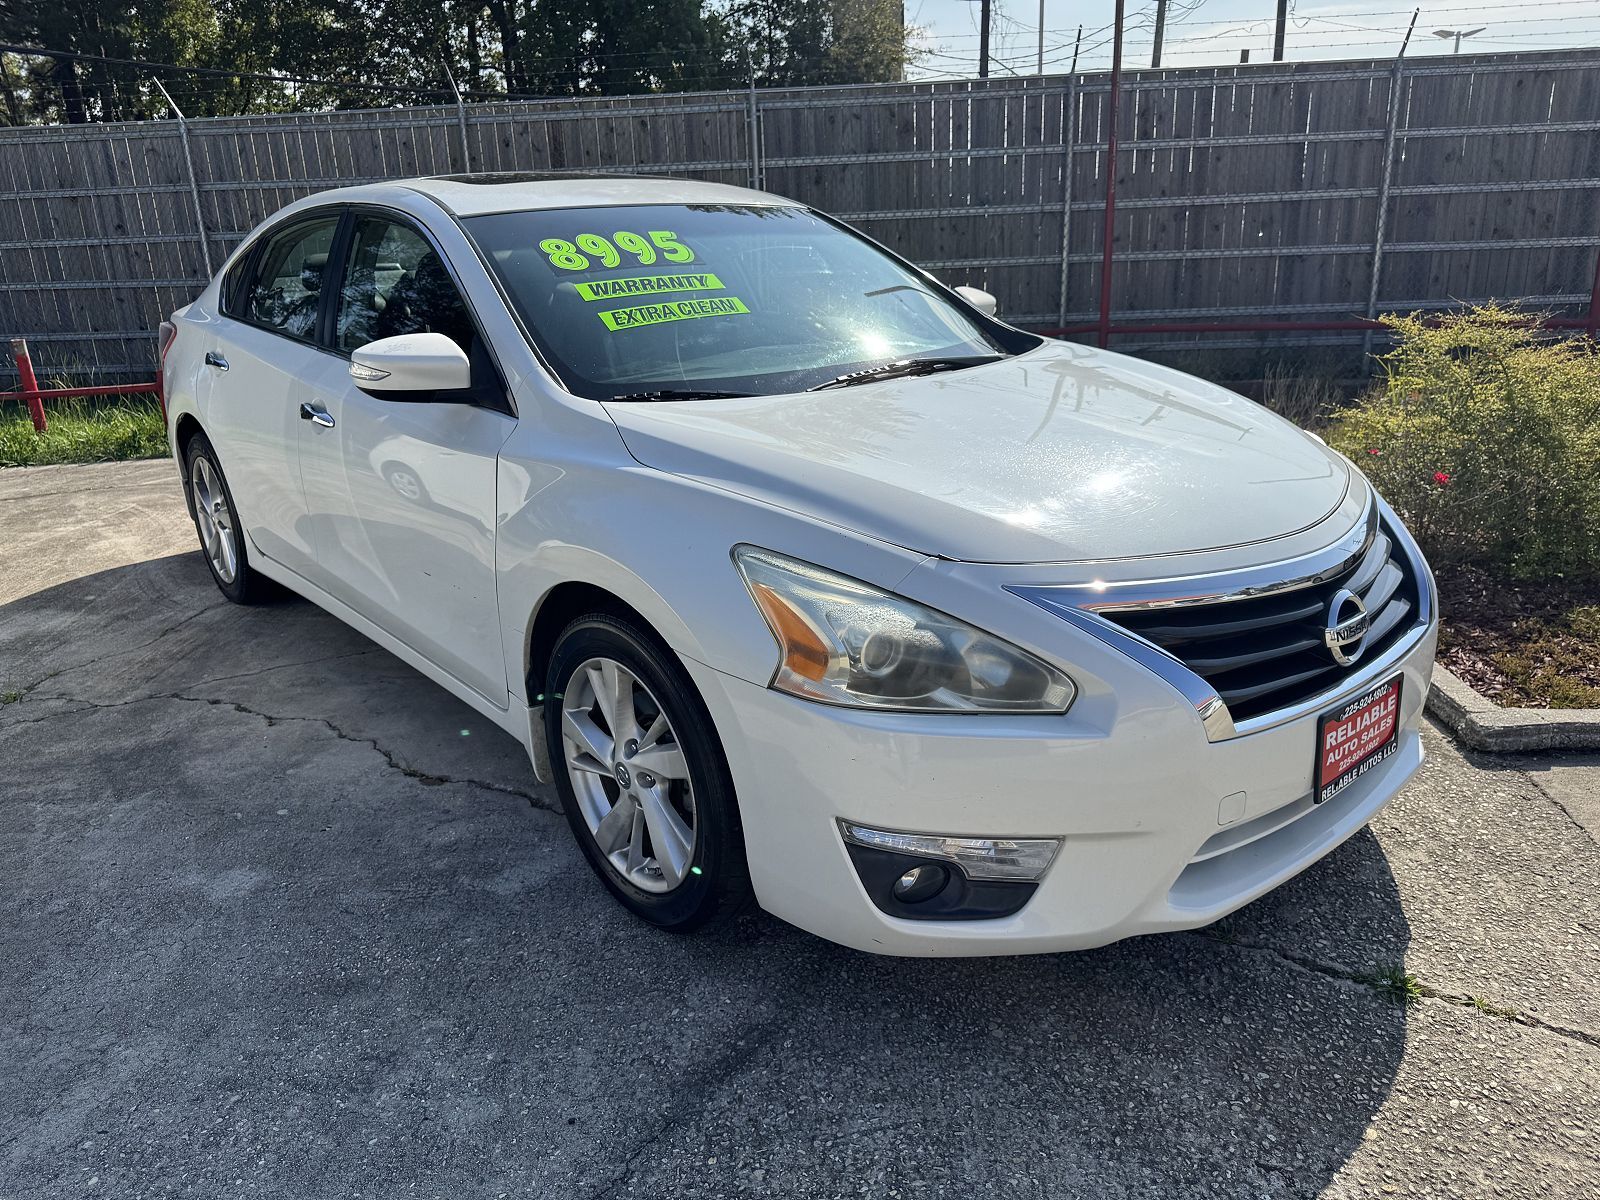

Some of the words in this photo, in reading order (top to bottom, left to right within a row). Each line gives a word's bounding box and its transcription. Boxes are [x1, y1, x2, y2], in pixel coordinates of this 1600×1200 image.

[539, 231, 695, 271] 8995
[588, 275, 708, 297] WARRANTY
[611, 303, 676, 327] EXTRA
[678, 302, 738, 317] CLEAN
[1326, 694, 1396, 750] RELIABLE
[1326, 738, 1358, 766] AUTO
[1360, 715, 1393, 742] SALES
[1321, 769, 1358, 802] RELIABLE
[1358, 752, 1382, 776] AUTOS
[1383, 742, 1397, 759] LLC
[1338, 737, 1380, 772] 225-924-1802
